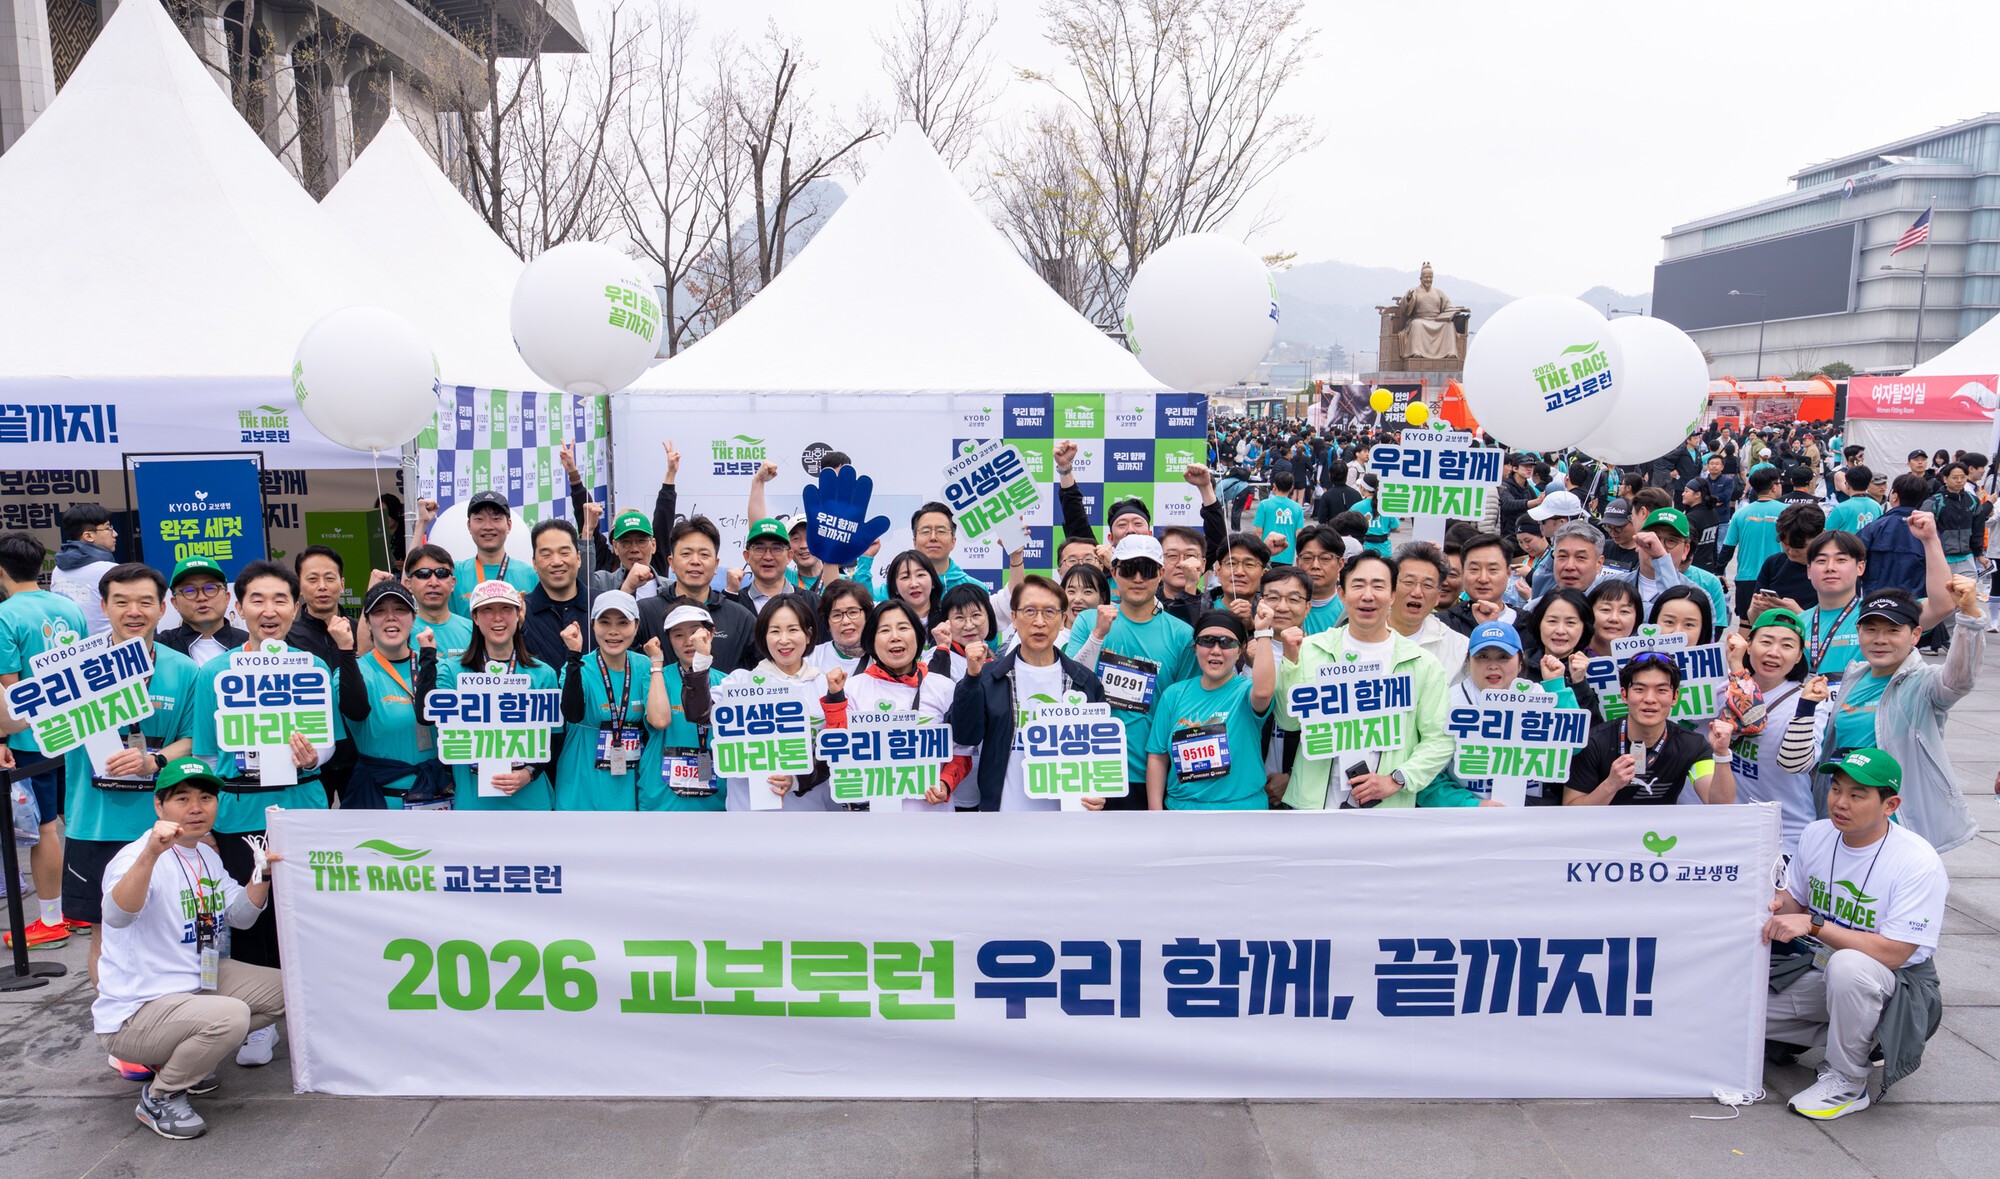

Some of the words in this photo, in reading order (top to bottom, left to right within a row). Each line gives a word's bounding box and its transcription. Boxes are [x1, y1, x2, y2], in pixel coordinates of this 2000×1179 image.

[604, 285, 638, 310] 우리
[609, 306, 655, 343] 끝까지!
[1532, 362, 1556, 377] 2026
[1535, 365, 1571, 393] THE
[1571, 350, 1609, 381] RACE
[1544, 370, 1613, 412] 교보로런
[1872, 382, 1926, 405] 여자탈의실
[0, 404, 119, 443] 끝까지!
[239, 416, 260, 429] THE
[262, 416, 289, 428] RACE
[1012, 407, 1028, 417] 우리
[1029, 407, 1045, 417] 함께
[1016, 417, 1042, 427] 끝까지!
[1065, 410, 1077, 420] THE
[1077, 410, 1094, 420] RACE
[1116, 414, 1142, 422] KYOBO
[1165, 407, 1181, 417] 우리
[1181, 407, 1198, 417] 함께
[1168, 417, 1195, 427] 끝까지!
[240, 429, 290, 443] 교보로런
[1405, 433, 1443, 442] KYOBO
[1445, 435, 1469, 443] 교보생명
[712, 447, 734, 460] THE
[736, 447, 766, 460] RACE
[947, 455, 978, 477] KYOBO
[979, 443, 998, 457] 교보생명
[1113, 452, 1129, 462] 우리
[1130, 452, 1146, 461] 함께
[1371, 448, 1432, 479] 우리
[1439, 449, 1500, 482] 함께
[1117, 462, 1143, 471] 끝까지!
[0, 469, 100, 495] 보생명이
[945, 449, 1024, 511] 인생은
[169, 502, 206, 512] KYOBO
[208, 502, 231, 510] 교보생명
[958, 476, 1040, 540] 마라톤
[1381, 483, 1484, 517] 끝까지!
[160, 519, 201, 542] 완주
[204, 517, 243, 539] 세컷
[816, 511, 837, 527] 우리
[837, 517, 859, 533] 함께
[817, 525, 851, 544] 끝까지!
[174, 540, 233, 562] 이벤트
[1023, 549, 1041, 558] 까지!
[1869, 598, 1898, 608] Callaway
[35, 646, 77, 668] KYOBO
[78, 637, 104, 653] 교보생명
[1615, 638, 1655, 651] KYOBO
[1658, 637, 1684, 645] 교보생명
[236, 657, 279, 666] KYOBO
[282, 657, 308, 665] 교보생명
[1320, 665, 1356, 676] KYOBO
[1358, 664, 1380, 672] 교보생명
[1586, 658, 1630, 690] 우
[10, 667, 81, 718] 우리
[79, 641, 150, 692] 함께
[221, 672, 325, 708] 인생은
[461, 676, 501, 685] KYOBO
[503, 677, 527, 685] 교보생명
[1105, 672, 1143, 692] 90291
[727, 687, 764, 698] KYOBO
[766, 687, 790, 695] 교보생명
[1291, 682, 1349, 719] 우리
[1354, 675, 1412, 713] 함께
[1485, 693, 1526, 703] KYOBO
[1528, 696, 1554, 704] 교보생명
[1603, 684, 1715, 722] 끝지!
[36, 682, 150, 753] 끝까지!
[429, 693, 491, 723] 우리
[498, 692, 560, 723] 함께
[715, 701, 805, 737] 인생은
[852, 713, 889, 724] KYOBO
[892, 713, 916, 721] 교보생명
[1041, 707, 1080, 717] KYOBO
[221, 711, 328, 746] 마라톤
[1305, 713, 1401, 756] 끝까지!
[1449, 709, 1512, 740] 우리
[1521, 710, 1586, 743] 함께
[442, 729, 547, 760] 끝까지!
[820, 731, 881, 763] 우리
[888, 728, 949, 760] 함께
[1027, 722, 1121, 757] 인생은
[717, 738, 808, 773] 마라톤
[1183, 744, 1215, 761] 95116
[1459, 745, 1567, 779] 끝까지!
[675, 765, 699, 779] 9512
[833, 764, 937, 799] 끝까지!
[1028, 759, 1123, 794] 마라톤
[308, 852, 343, 865] 2026
[311, 864, 360, 891] THE
[365, 864, 436, 891] RACE
[443, 864, 563, 895] 교보로런
[1566, 861, 1670, 884] KYOBO
[1676, 862, 1739, 884] 교보생명
[1834, 897, 1877, 928] RACE
[382, 938, 598, 1012] 2026
[620, 939, 956, 1020] 교보로런
[975, 939, 1140, 1019] 우리
[1161, 938, 1355, 1021] 함께,
[1375, 936, 1657, 1018] 끝까지!
